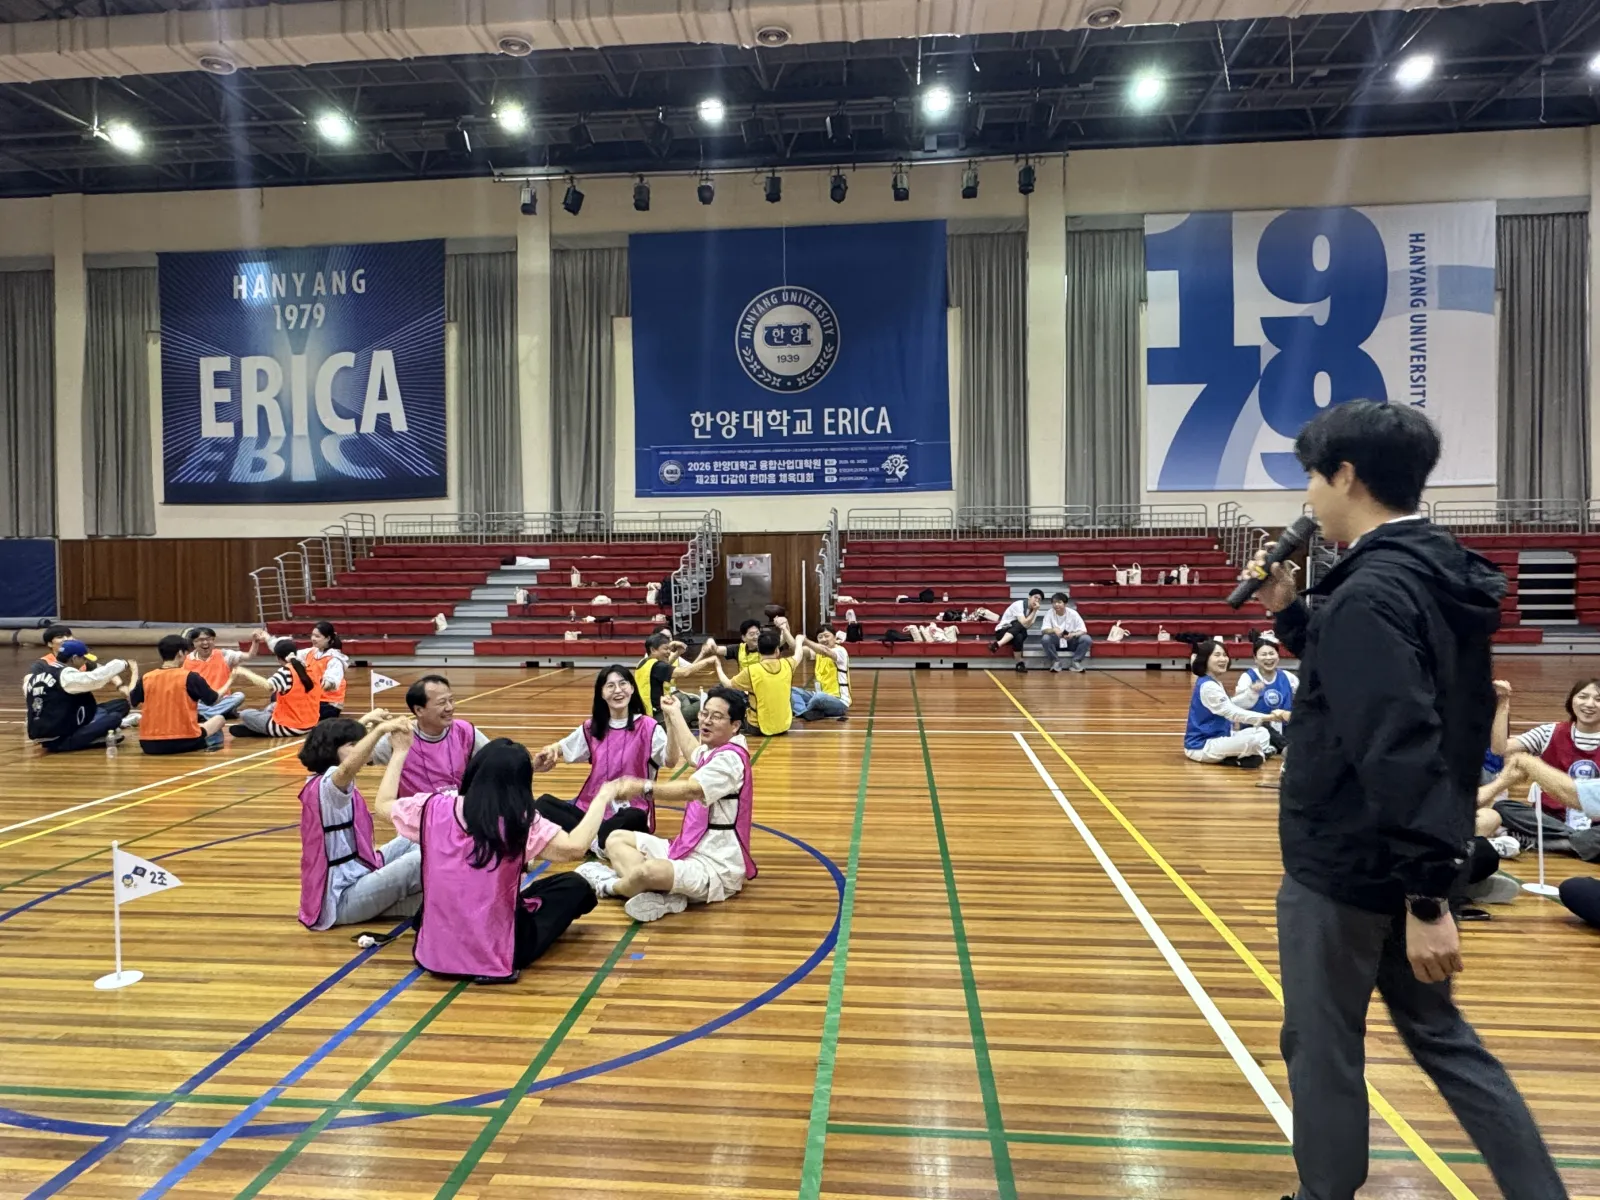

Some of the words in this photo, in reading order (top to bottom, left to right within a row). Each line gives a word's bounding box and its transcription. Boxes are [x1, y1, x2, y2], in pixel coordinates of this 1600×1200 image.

[233, 268, 366, 299] HANYANG
[1409, 232, 1427, 308] HANYANG
[273, 303, 326, 331] 1979
[740, 293, 778, 339] HANYANG
[781, 291, 836, 335] UNIVERSITY
[776, 354, 800, 363] 1939
[1410, 313, 1427, 409] UNIVERSITY
[199, 350, 408, 438] ERICA
[690, 408, 813, 439] 한양대학교
[824, 406, 892, 435] ERICA
[687, 461, 711, 472] 2026
[713, 460, 757, 471] 한양대학교
[759, 458, 821, 471] 융합산업대학원
[695, 474, 718, 485] 제2회
[749, 473, 776, 484] 한마음
[779, 472, 814, 483] 체육대회
[149, 870, 168, 886] 2조
